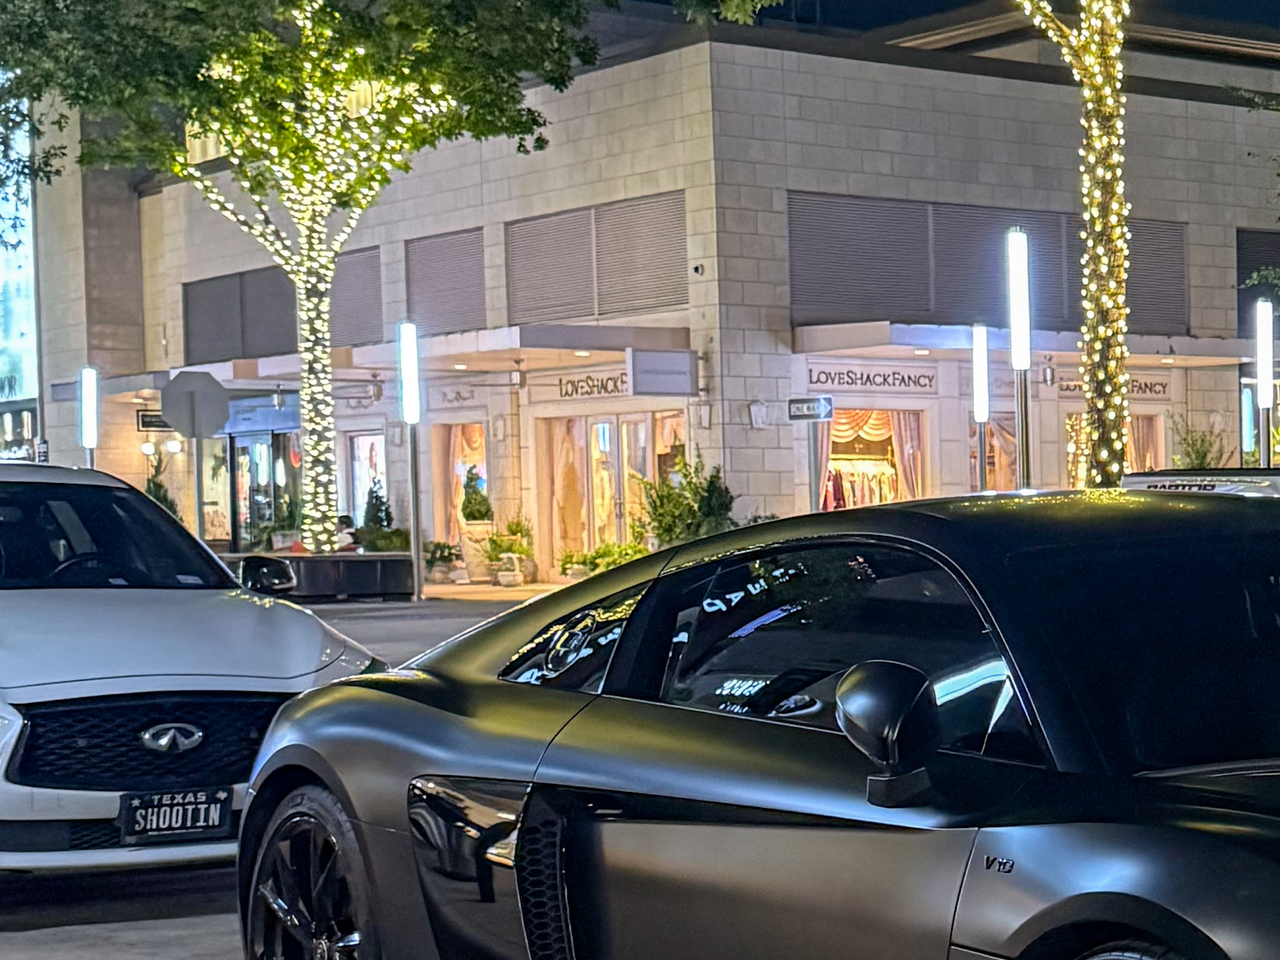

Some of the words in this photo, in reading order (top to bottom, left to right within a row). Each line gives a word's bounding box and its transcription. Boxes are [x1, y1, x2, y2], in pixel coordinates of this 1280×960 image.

[808, 369, 935, 388] LOVESHACKFANCY
[151, 791, 207, 805] TEXAS
[134, 803, 221, 831] SHOOTIN
